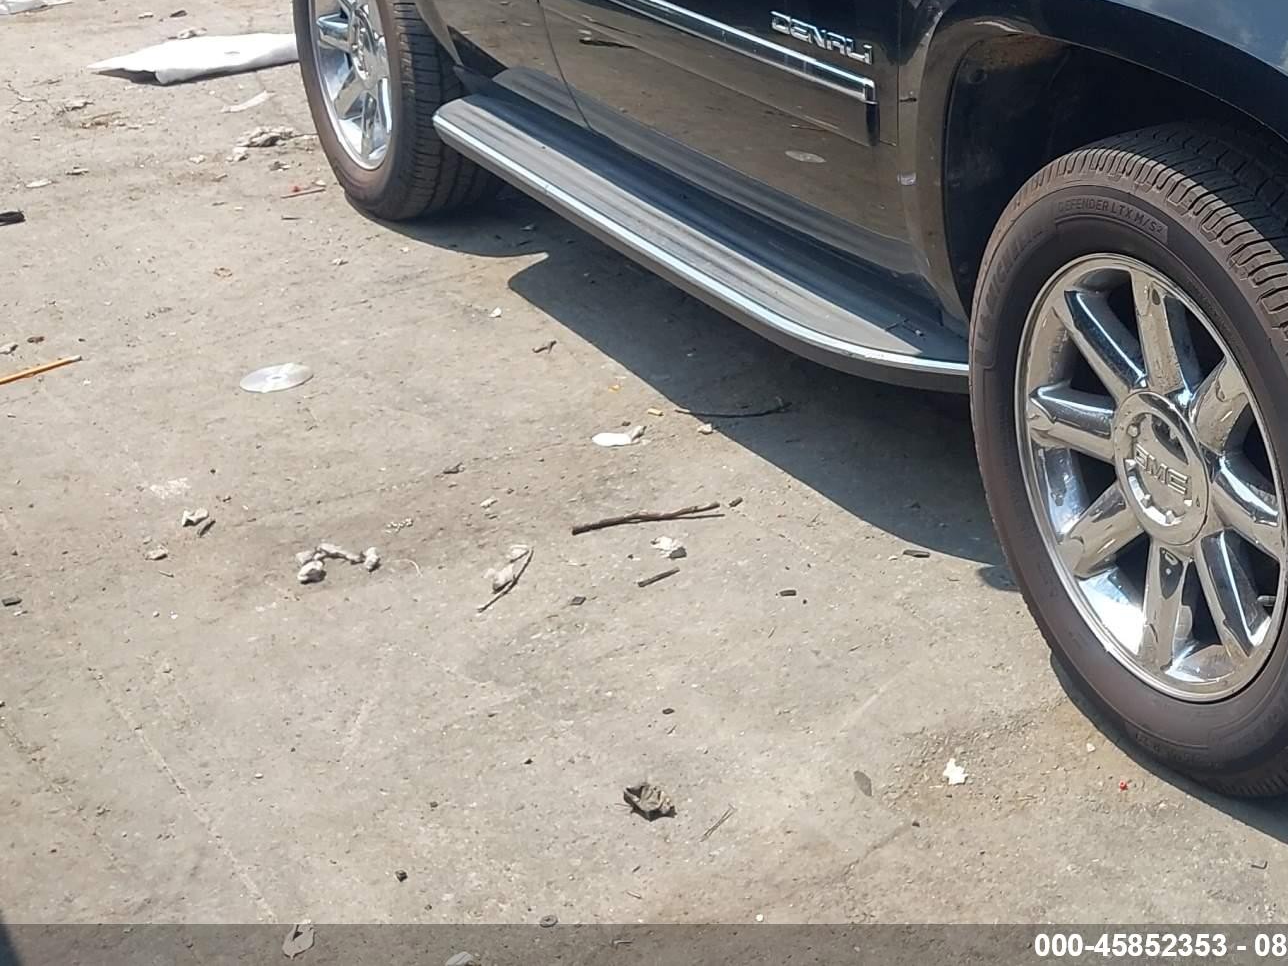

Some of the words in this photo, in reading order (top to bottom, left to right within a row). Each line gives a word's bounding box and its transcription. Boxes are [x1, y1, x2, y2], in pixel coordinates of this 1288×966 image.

[770, 10, 873, 65] DENALI
[1058, 197, 1109, 213] DEFENDER
[1111, 201, 1133, 220] LTX
[1134, 442, 1188, 495] GMC
